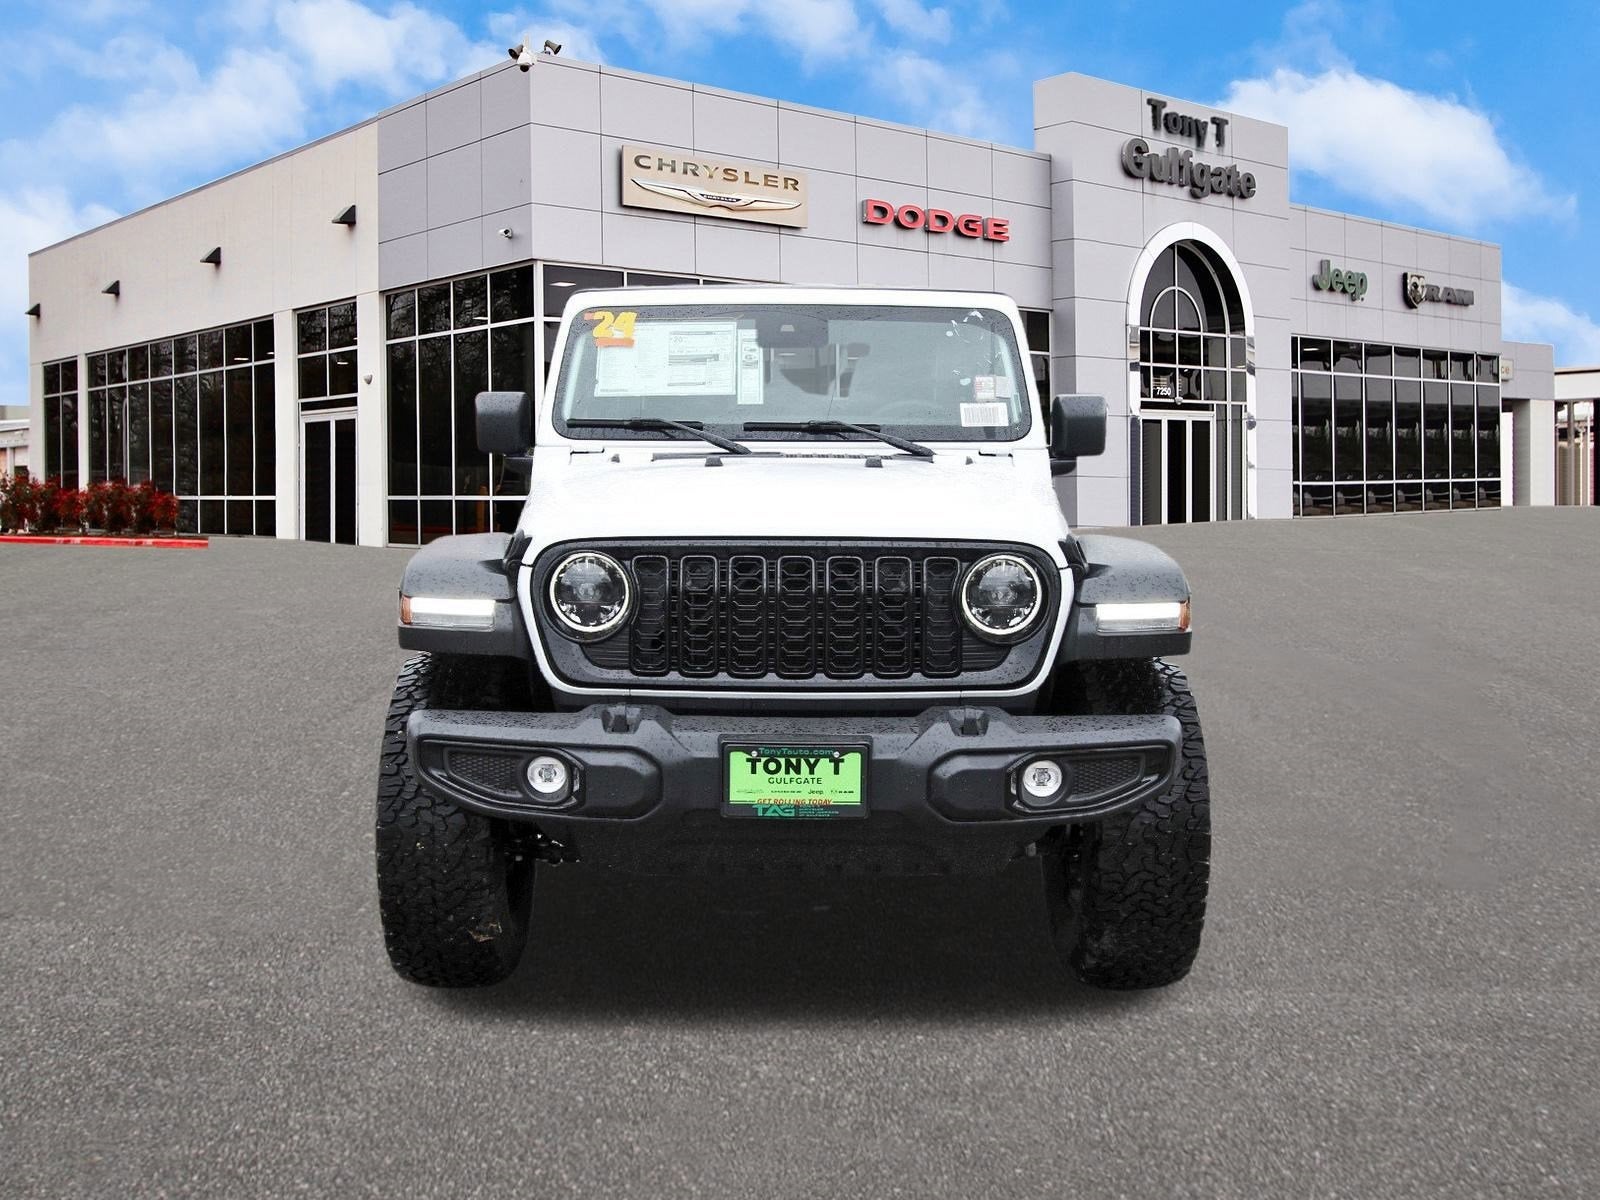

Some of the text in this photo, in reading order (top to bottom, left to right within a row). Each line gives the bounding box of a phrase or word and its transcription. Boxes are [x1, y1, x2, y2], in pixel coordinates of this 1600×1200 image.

[1147, 98, 1229, 148] Tony T
[633, 154, 801, 191] CHRYSLER
[1121, 138, 1257, 199] Gulfgate
[863, 199, 1010, 242] DODGE
[1312, 259, 1368, 301] Jeep
[1425, 284, 1475, 306] RAM
[1156, 386, 1172, 396] 7250
[746, 757, 845, 775] TONY T
[767, 777, 823, 785] GULFGATE
[773, 798, 806, 806] ROLLING
[808, 798, 833, 806] TODAY
